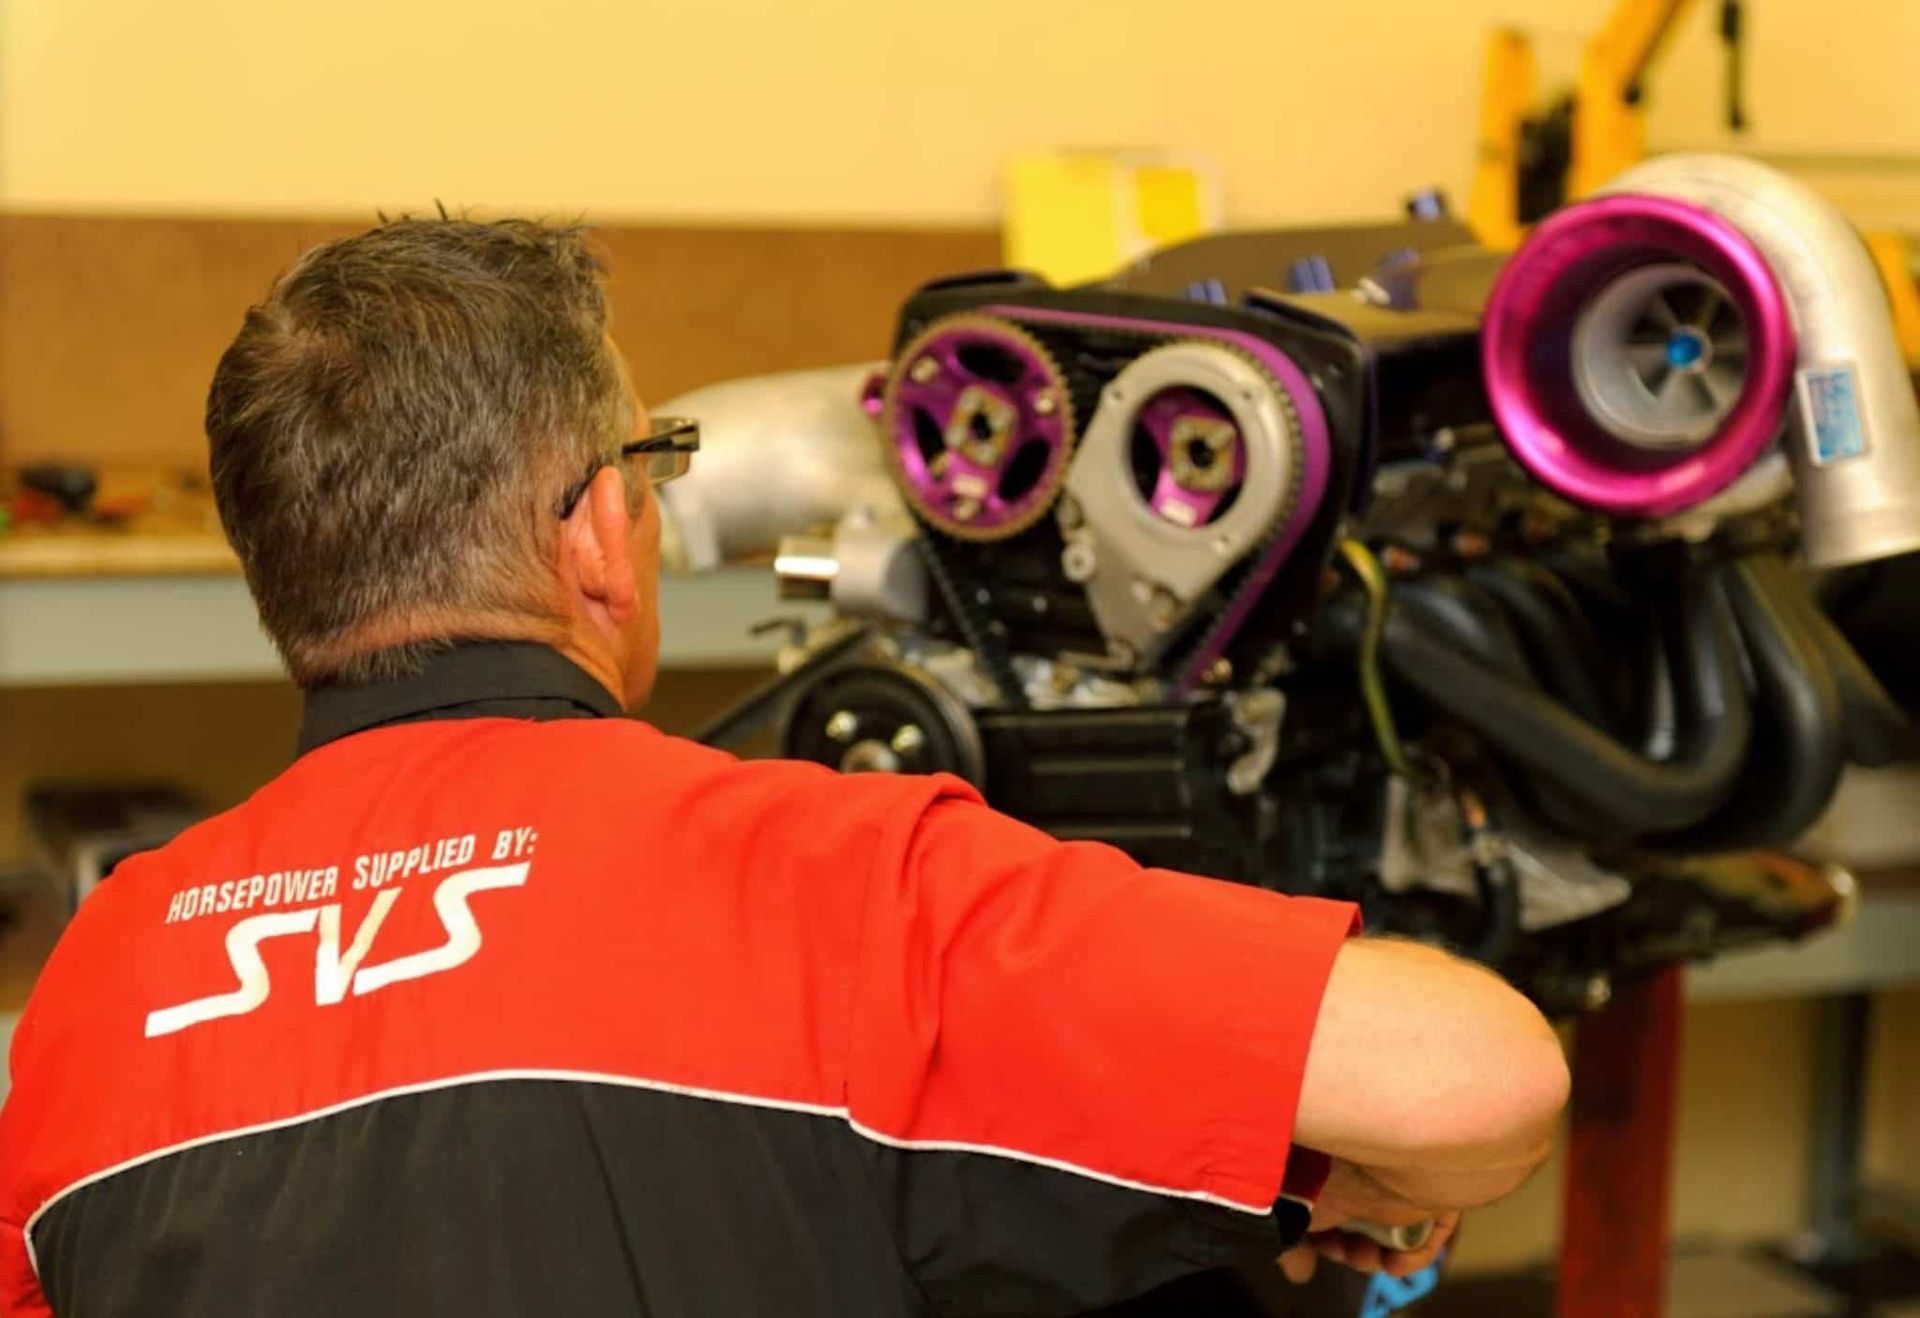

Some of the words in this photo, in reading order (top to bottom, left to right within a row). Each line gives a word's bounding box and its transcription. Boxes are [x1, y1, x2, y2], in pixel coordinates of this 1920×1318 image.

[165, 866, 339, 924] HORSEPOWER
[353, 834, 476, 890] SUPPLIED
[492, 826, 538, 860] BY:
[145, 861, 531, 1038] SVS
